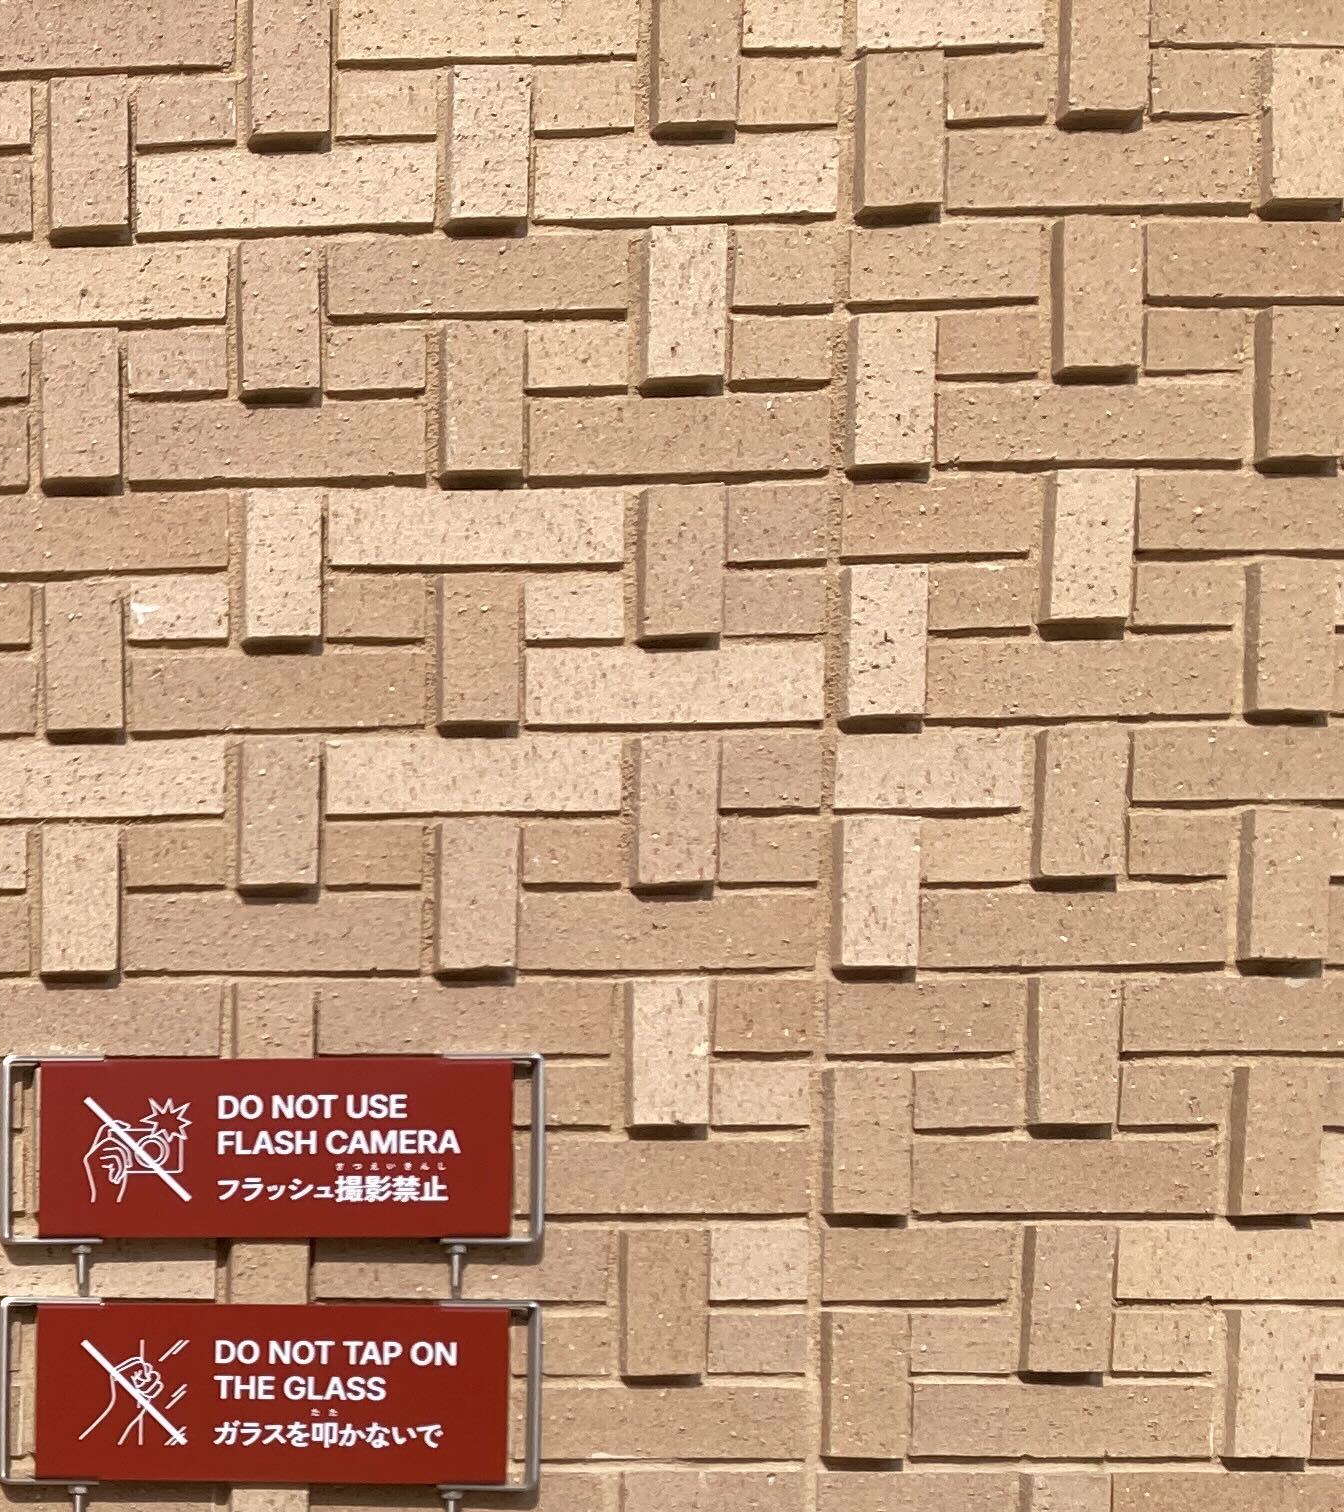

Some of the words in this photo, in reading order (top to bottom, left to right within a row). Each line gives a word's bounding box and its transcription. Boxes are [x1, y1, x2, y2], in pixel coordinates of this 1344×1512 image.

[217, 1093, 264, 1120] DO
[271, 1093, 339, 1120] NOT
[346, 1093, 408, 1120] USE
[217, 1129, 318, 1155] FLASH
[325, 1129, 462, 1155] CAMERA
[217, 1175, 449, 1203] フラッシュ撮影禁止
[214, 1339, 261, 1367] DO
[268, 1339, 336, 1367] NOT
[342, 1340, 403, 1367] TAP
[409, 1340, 458, 1367] ON
[213, 1375, 276, 1402] THE
[283, 1375, 387, 1402] GLASS
[213, 1420, 444, 1449] ガラスを叩かないで
